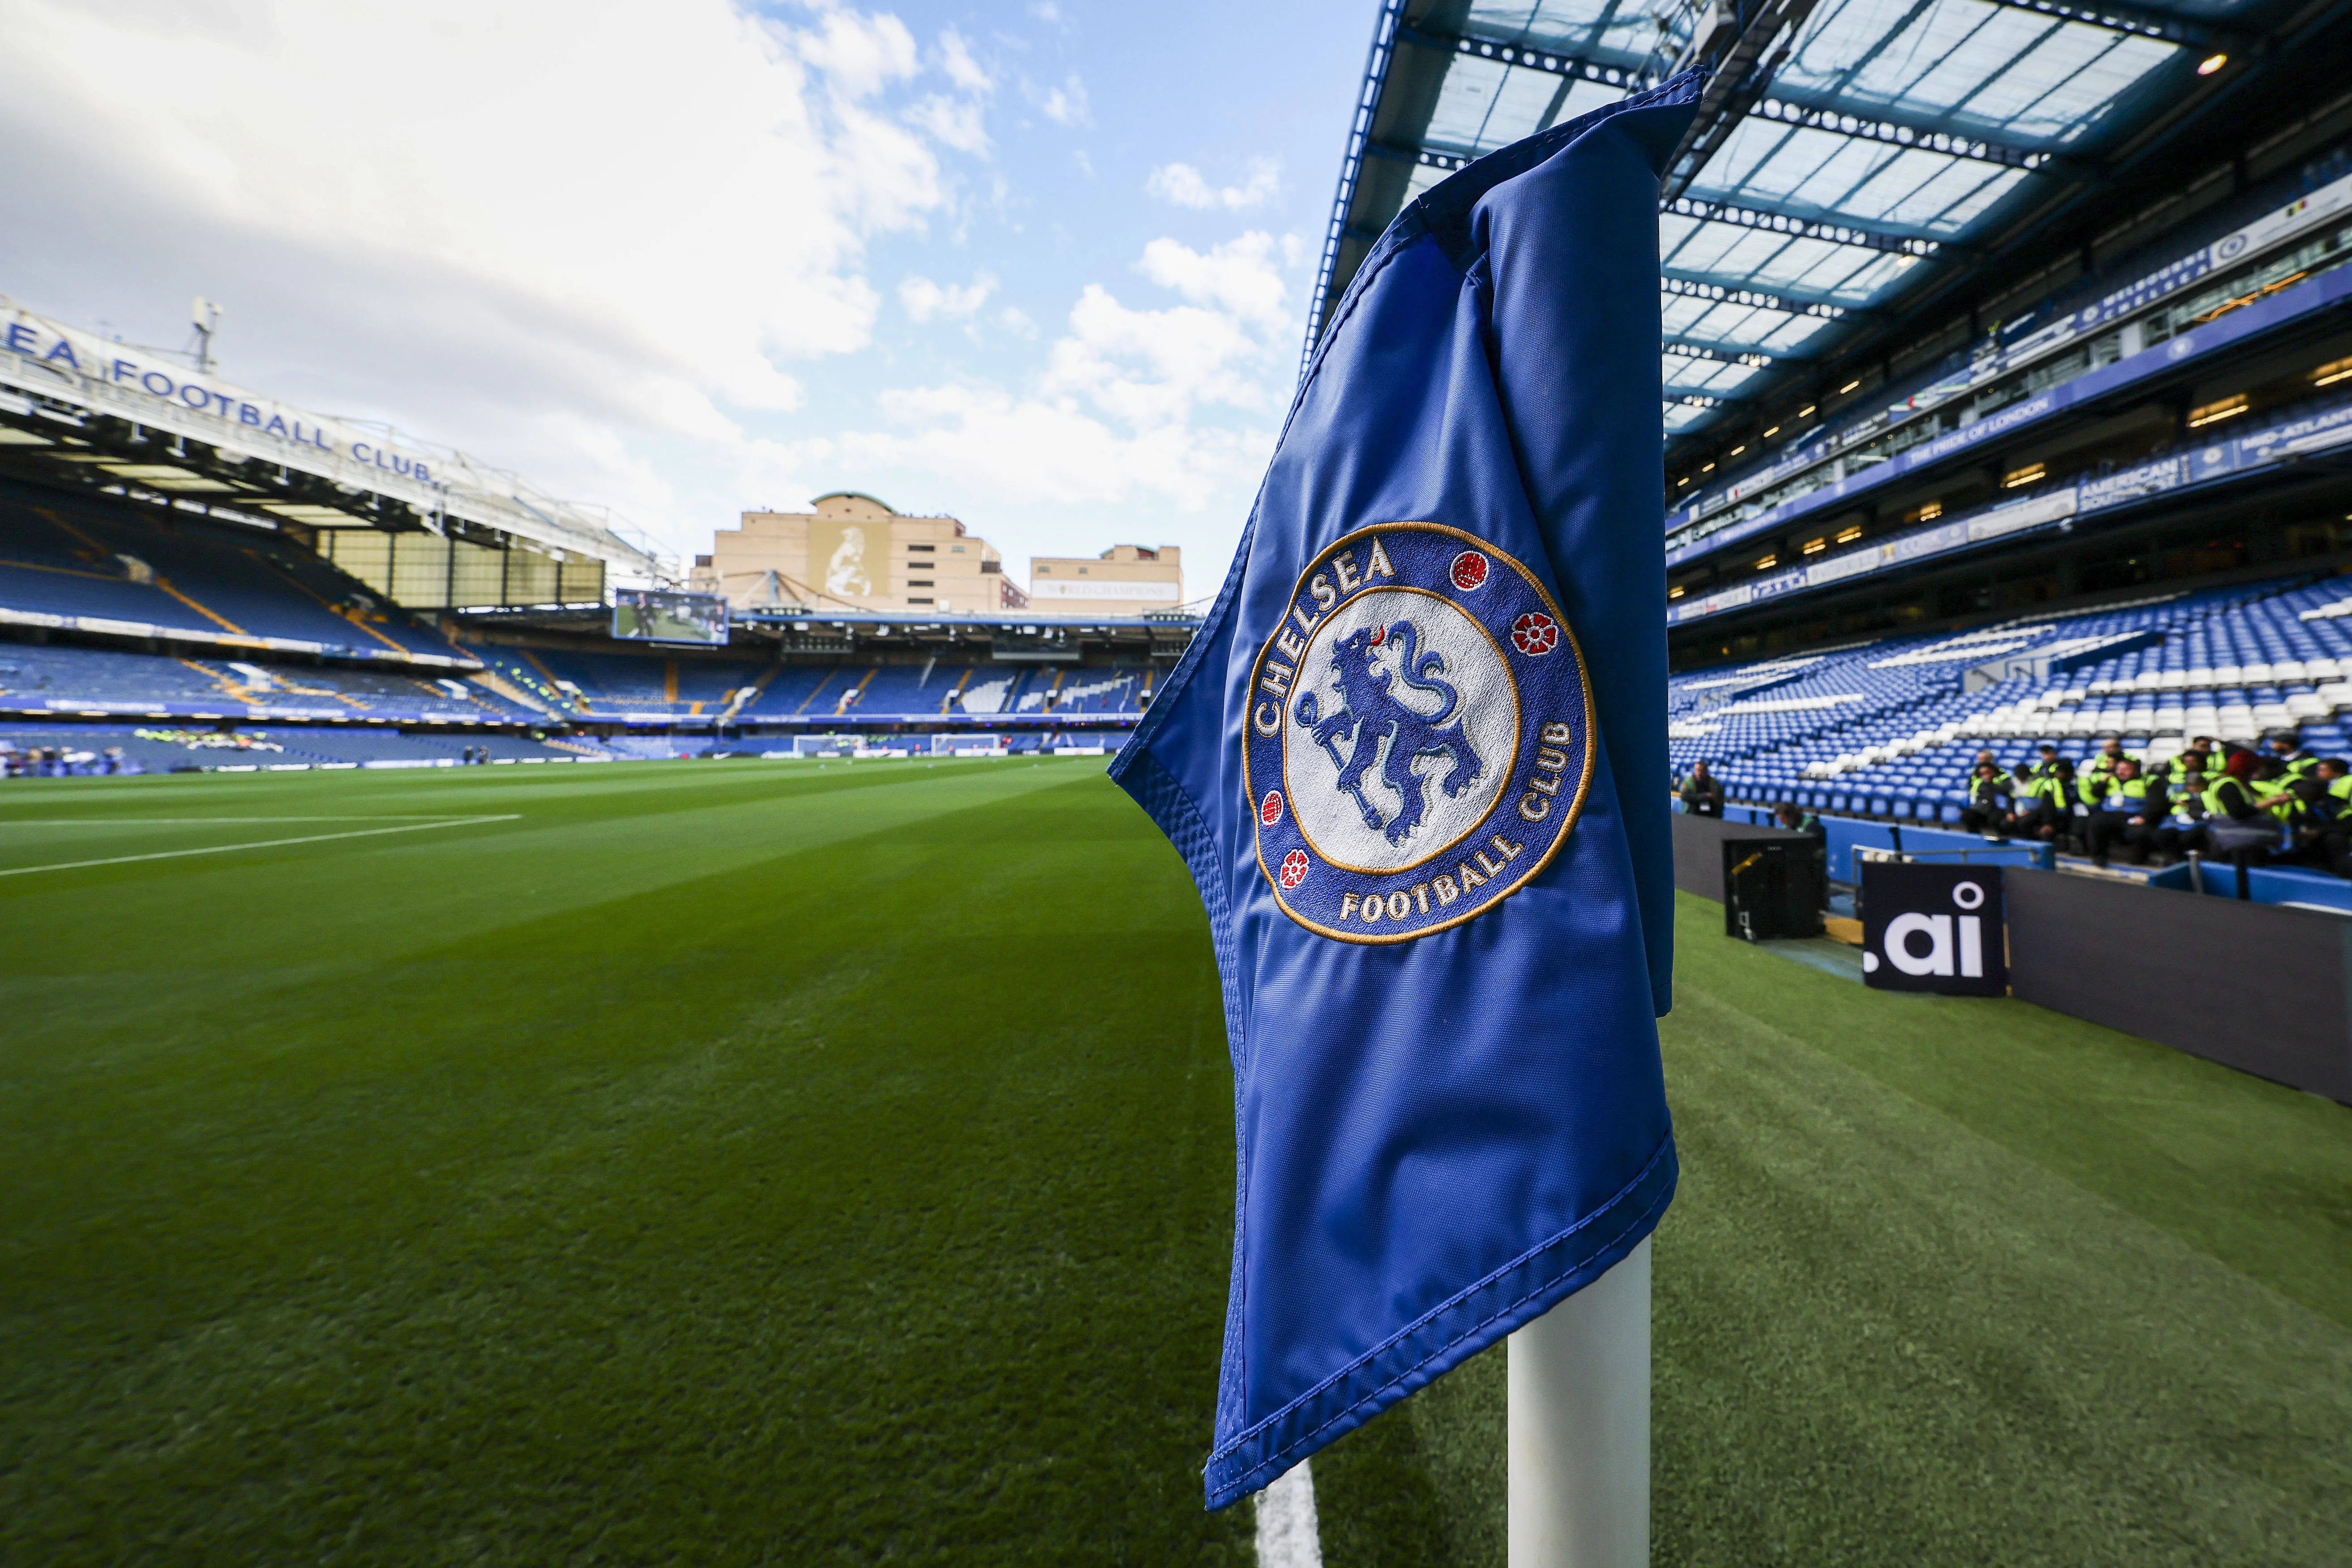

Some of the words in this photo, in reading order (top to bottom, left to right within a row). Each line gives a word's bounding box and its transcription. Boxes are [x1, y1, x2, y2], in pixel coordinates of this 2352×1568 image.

[2104, 264, 2207, 320] CHELSEA
[113, 359, 332, 452] FOOTBALL
[352, 442, 430, 481] CLUB
[1988, 398, 2048, 432] LONDON
[2080, 457, 2179, 498] AMERICAN
[1254, 535, 1396, 738] CHELSEA
[1339, 834, 1525, 924] FOOTBALL
[1518, 721, 1572, 823] CLUB
